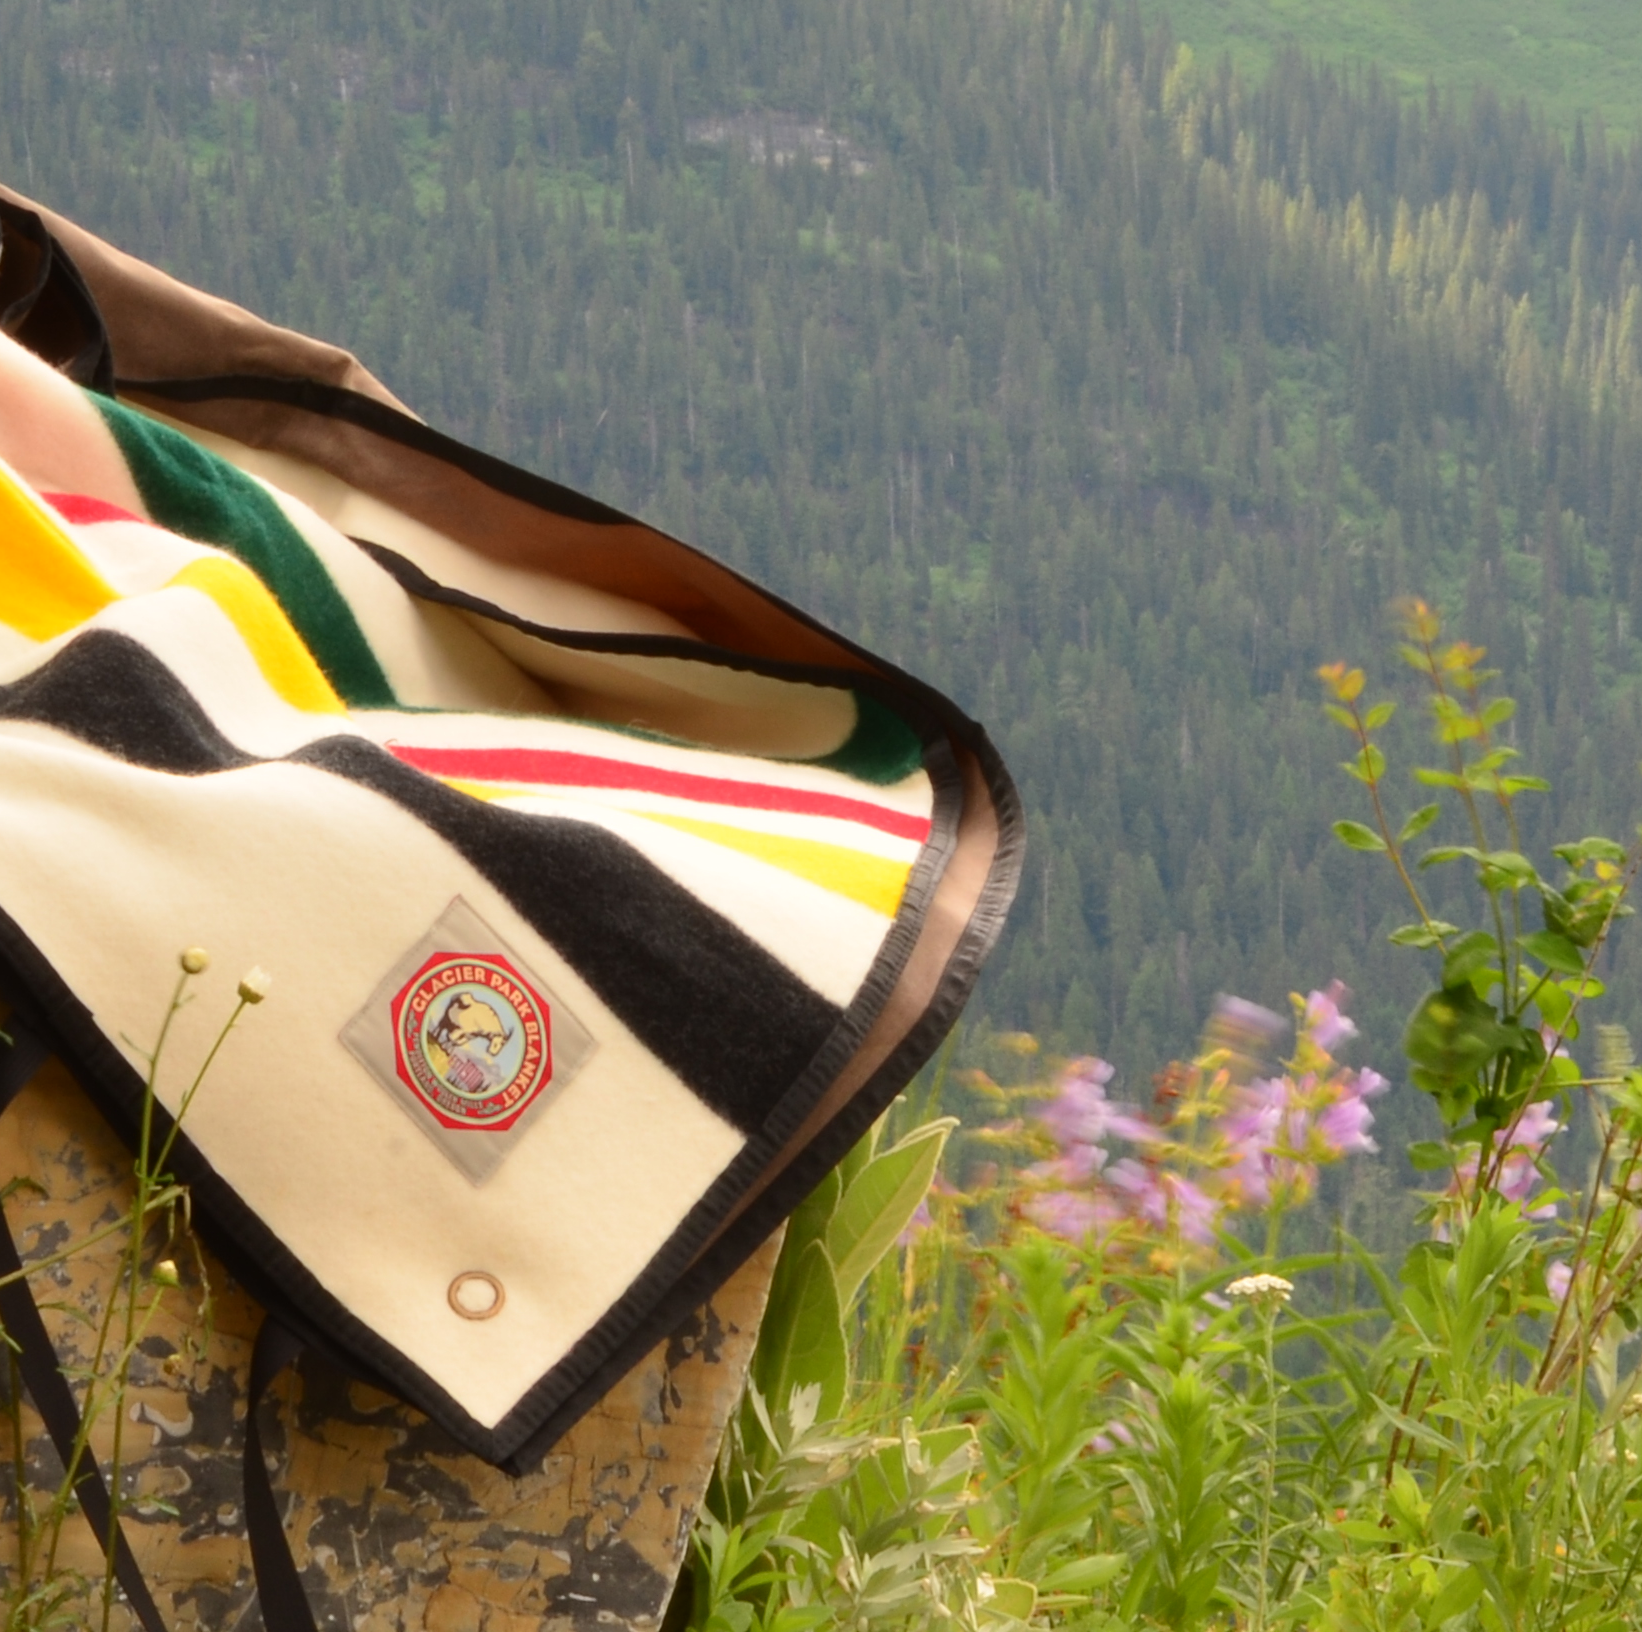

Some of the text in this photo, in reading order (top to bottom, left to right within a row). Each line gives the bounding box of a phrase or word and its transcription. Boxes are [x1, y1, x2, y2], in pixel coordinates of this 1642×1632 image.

[412, 966, 541, 1108] GLACIER PARK BLANKET
